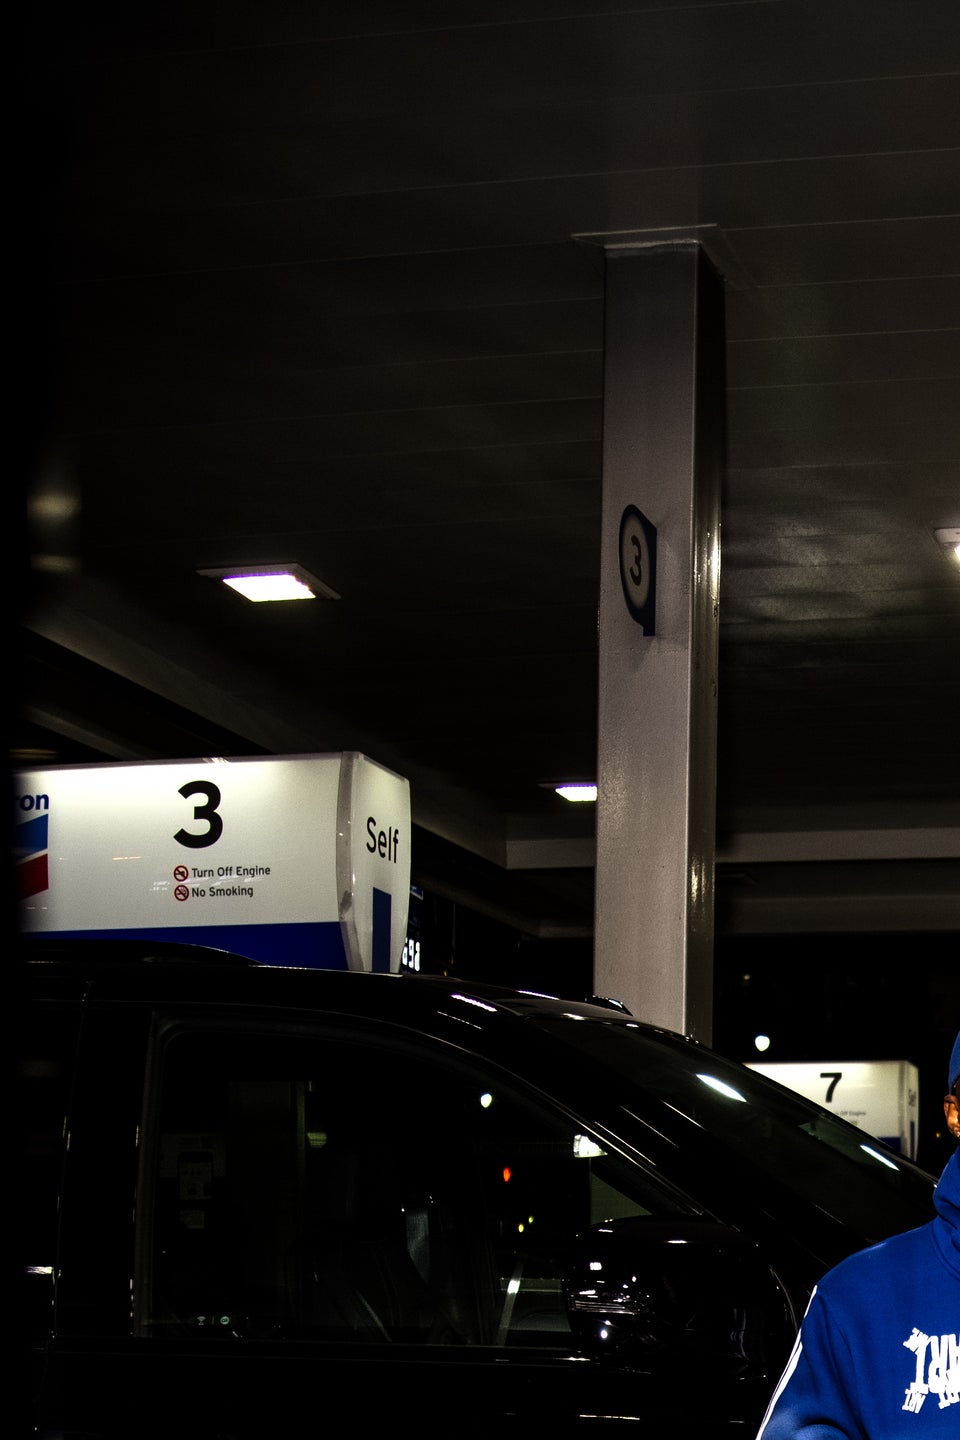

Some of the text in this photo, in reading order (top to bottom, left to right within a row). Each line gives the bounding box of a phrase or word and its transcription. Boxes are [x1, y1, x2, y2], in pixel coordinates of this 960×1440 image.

[630, 535, 642, 586] 3
[173, 780, 223, 849] 3
[366, 816, 399, 864] Self
[192, 865, 271, 878] Turn Off Engine
[191, 886, 254, 898] No Smoking
[820, 1072, 842, 1103] 7
